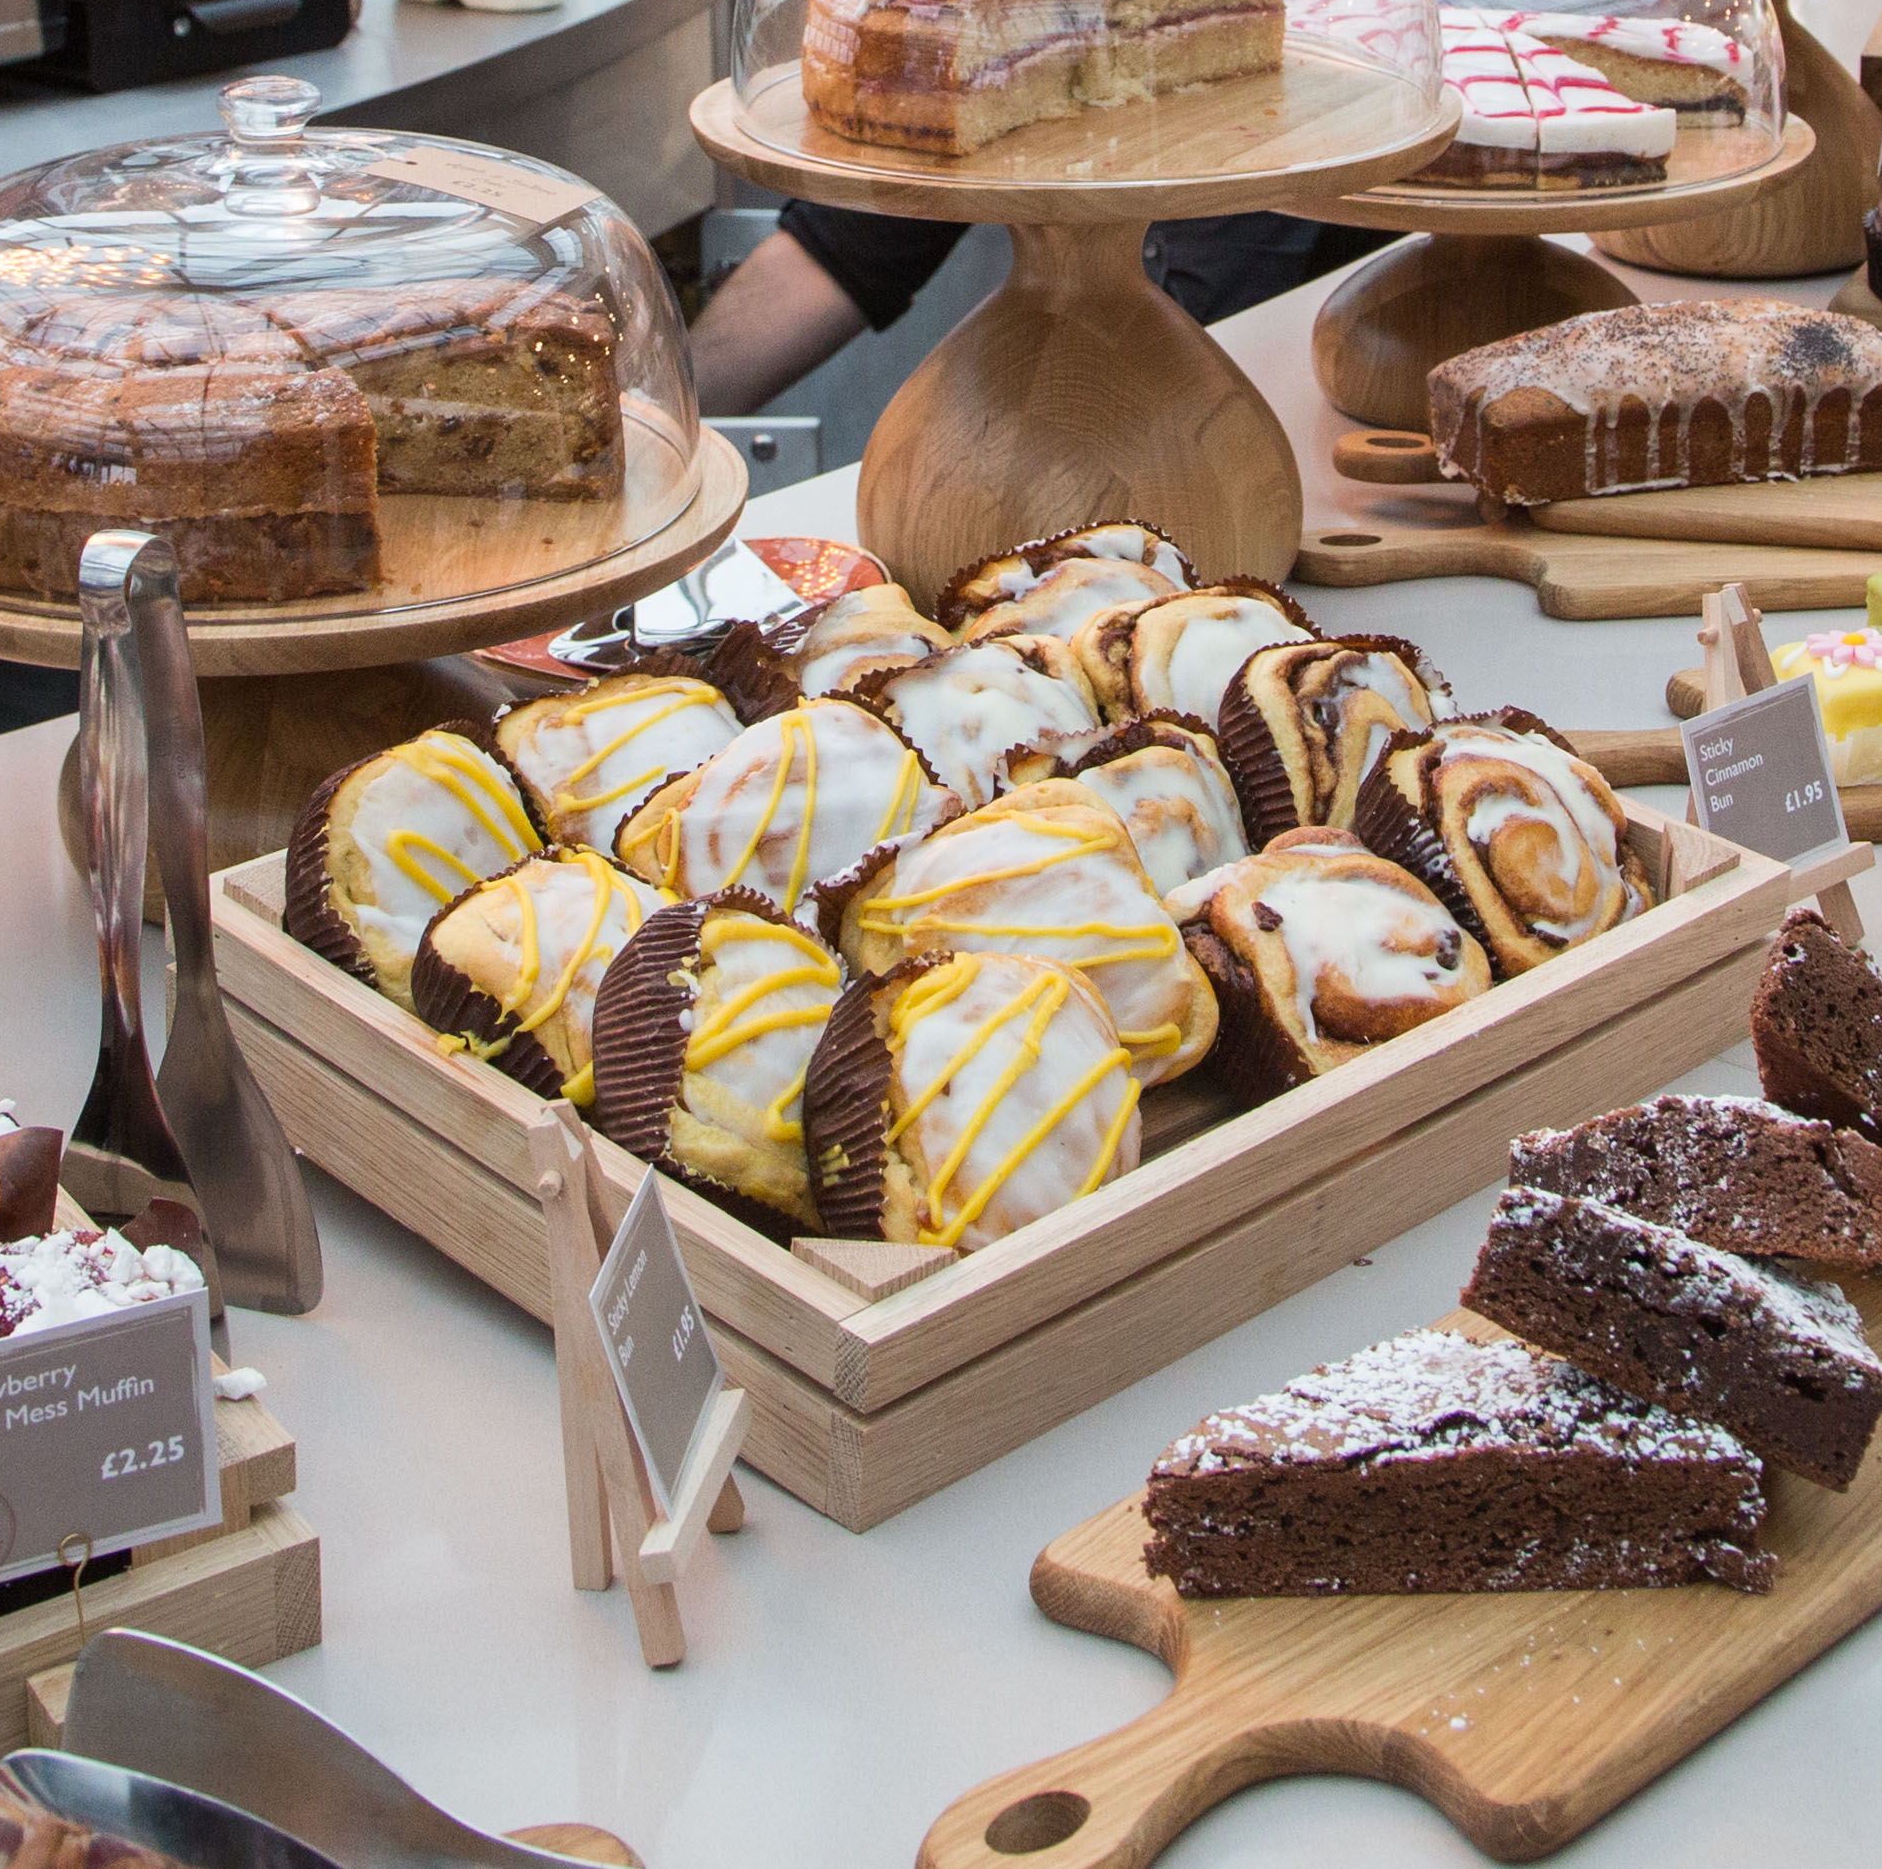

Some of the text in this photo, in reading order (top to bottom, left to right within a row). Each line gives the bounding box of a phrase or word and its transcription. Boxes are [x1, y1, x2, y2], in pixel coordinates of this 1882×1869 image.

[1699, 737, 1734, 761] Sticky
[1705, 753, 1764, 786] Cinnamon
[1709, 781, 1823, 813] Bun £1.95
[624, 1249, 647, 1298] Lemon
[618, 1335, 635, 1367] Bun
[672, 1305, 695, 1362] £1.95
[5, 1400, 68, 1429] Mess
[77, 1376, 154, 1411] Muffin
[101, 1435, 184, 1480] £2.25
